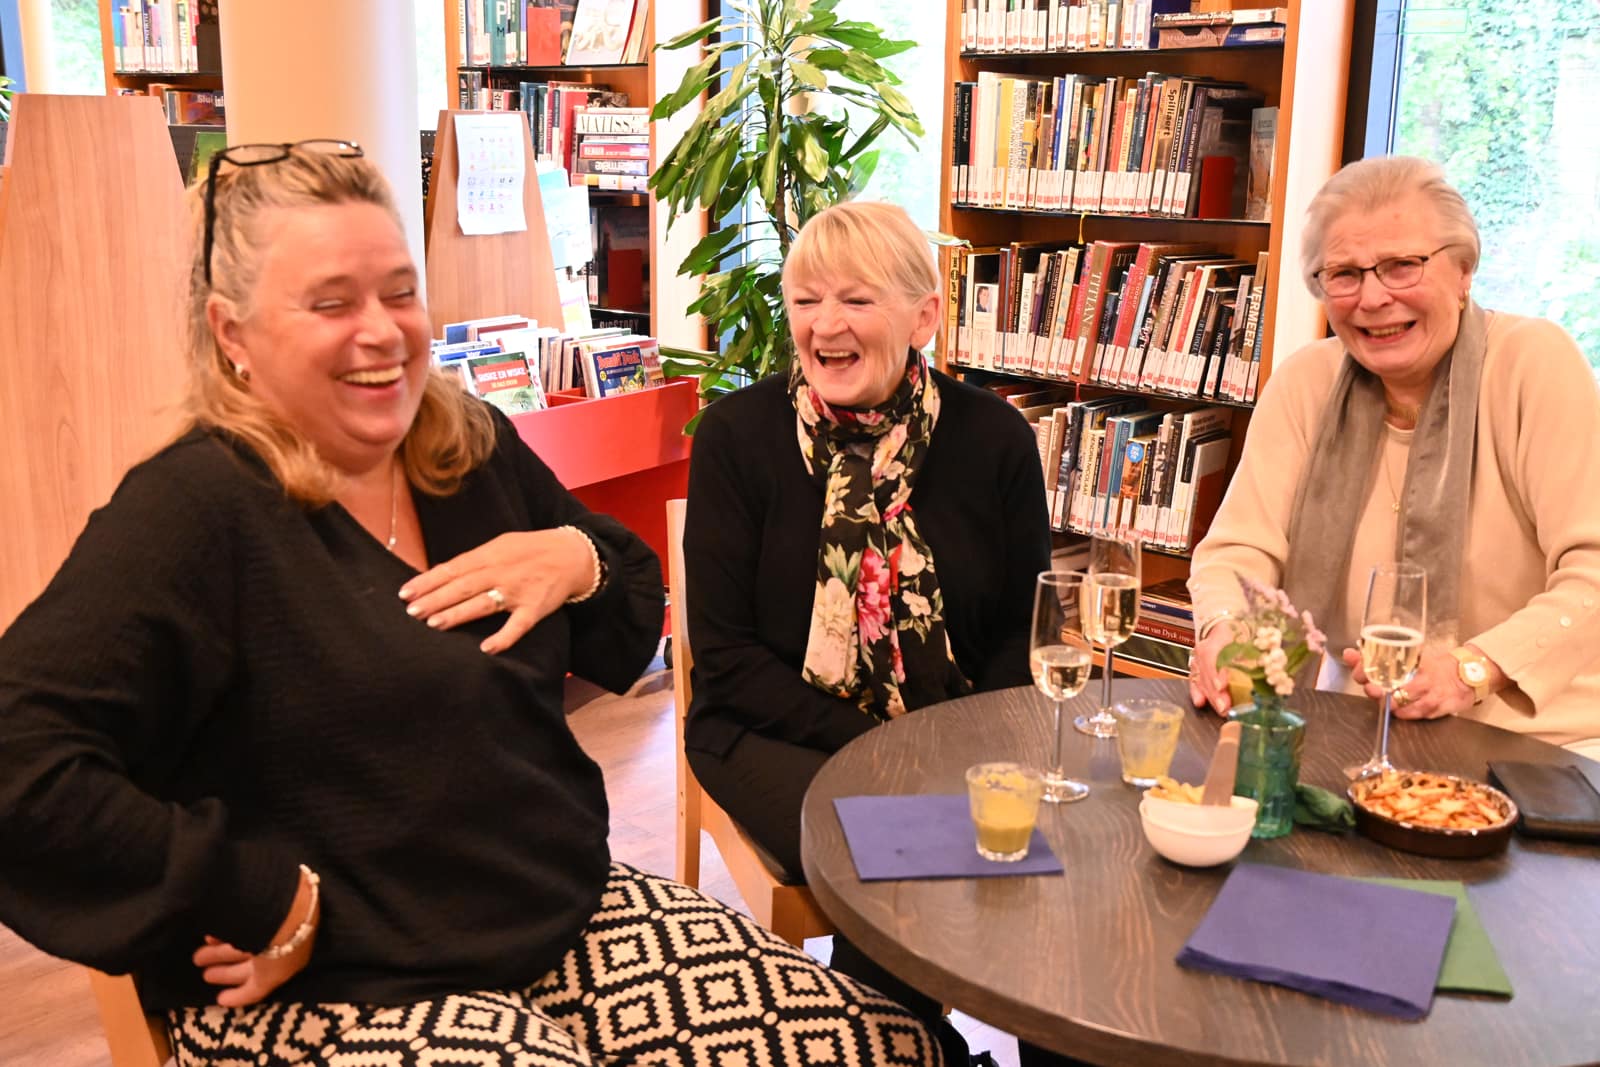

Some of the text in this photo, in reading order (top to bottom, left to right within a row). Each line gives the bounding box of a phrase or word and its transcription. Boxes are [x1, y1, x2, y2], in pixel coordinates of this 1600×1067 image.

[581, 115, 640, 133] MATISSE
[1164, 89, 1177, 136] Spilliaert
[1082, 272, 1103, 324] TITIAN
[1244, 286, 1263, 348] VERMEER
[1039, 425, 1048, 465] VIENN
[1162, 628, 1177, 639] Dyck
